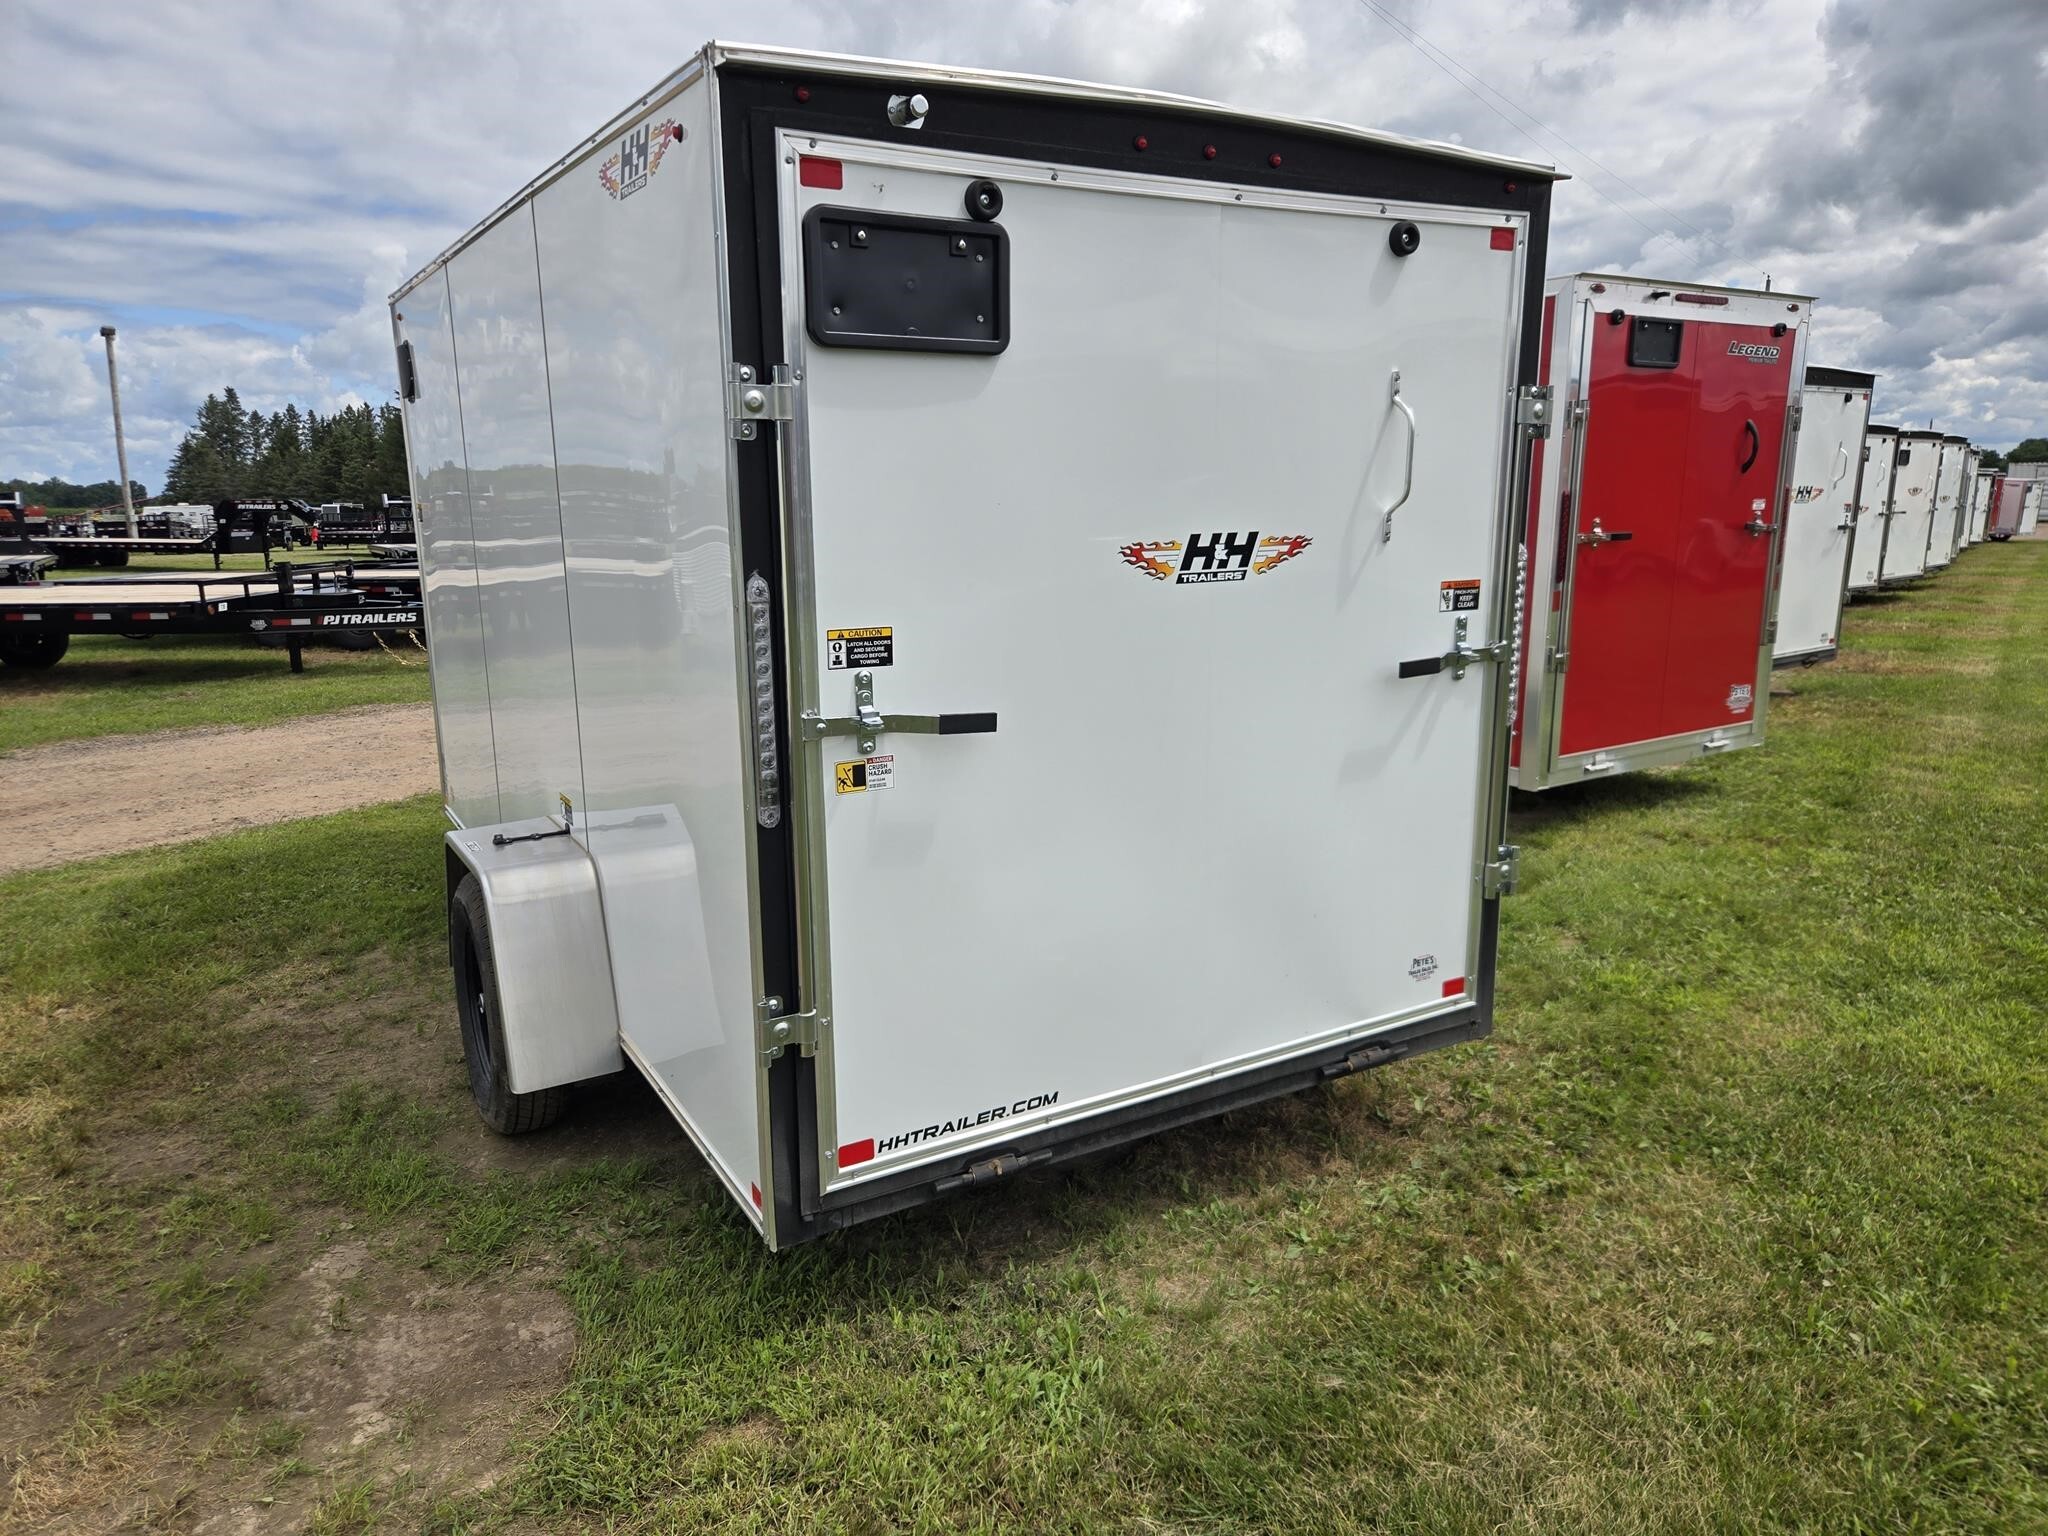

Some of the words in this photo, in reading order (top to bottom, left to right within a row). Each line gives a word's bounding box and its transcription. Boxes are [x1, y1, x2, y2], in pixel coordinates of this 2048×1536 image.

[1728, 341, 1780, 358] LEGEND
[1179, 531, 1259, 571] H&H
[1181, 572, 1244, 582] TRAILERS
[323, 615, 341, 625] PJ
[342, 612, 417, 625] TRAILERS
[848, 629, 882, 638] CAUTION
[868, 763, 888, 771] CRUSH
[868, 768, 892, 776] HAZARD
[878, 1091, 1059, 1154] HHTRAILER.COM
